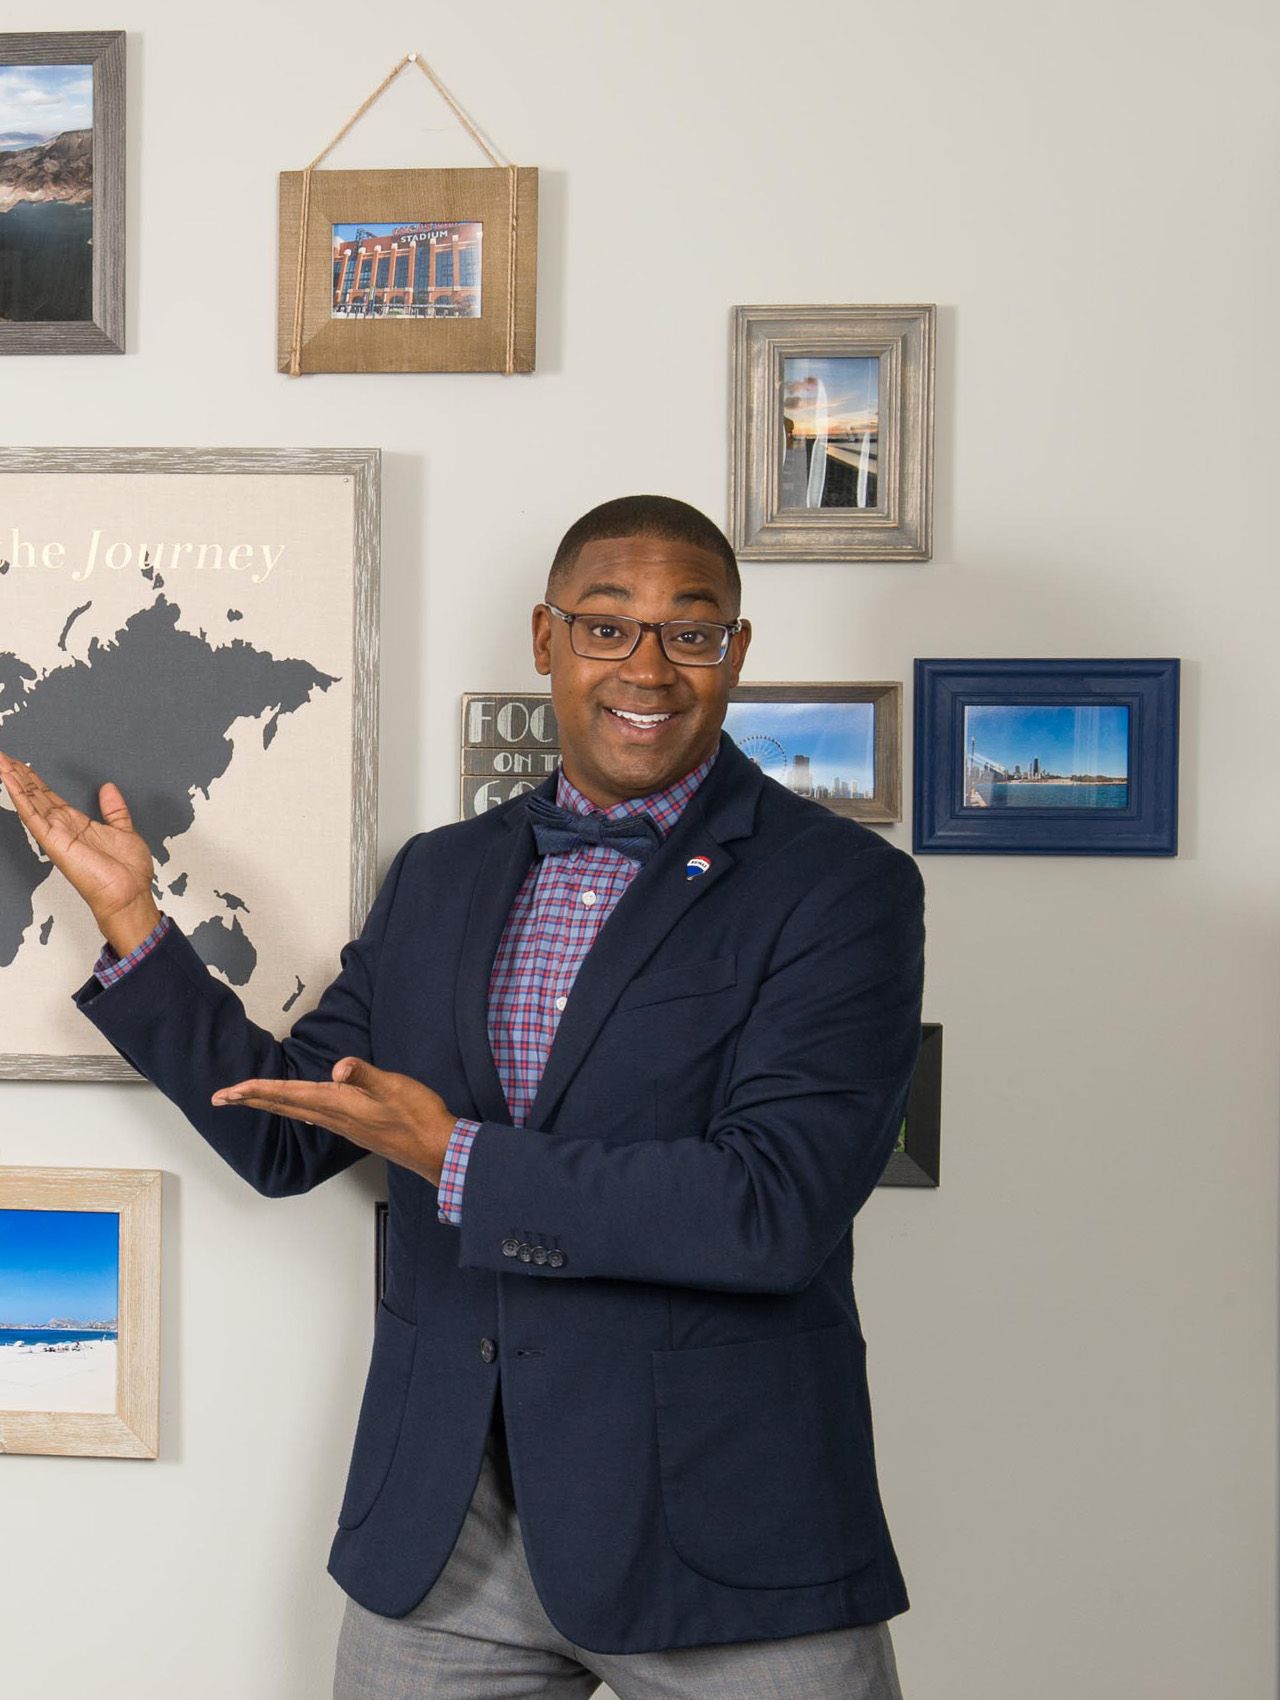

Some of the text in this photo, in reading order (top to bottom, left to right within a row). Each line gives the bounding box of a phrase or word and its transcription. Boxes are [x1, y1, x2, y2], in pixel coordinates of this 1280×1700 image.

[400, 230, 448, 243] STADIUM
[71, 529, 286, 584] Journey
[469, 702, 553, 743] FOC
[493, 752, 531, 772] ON
